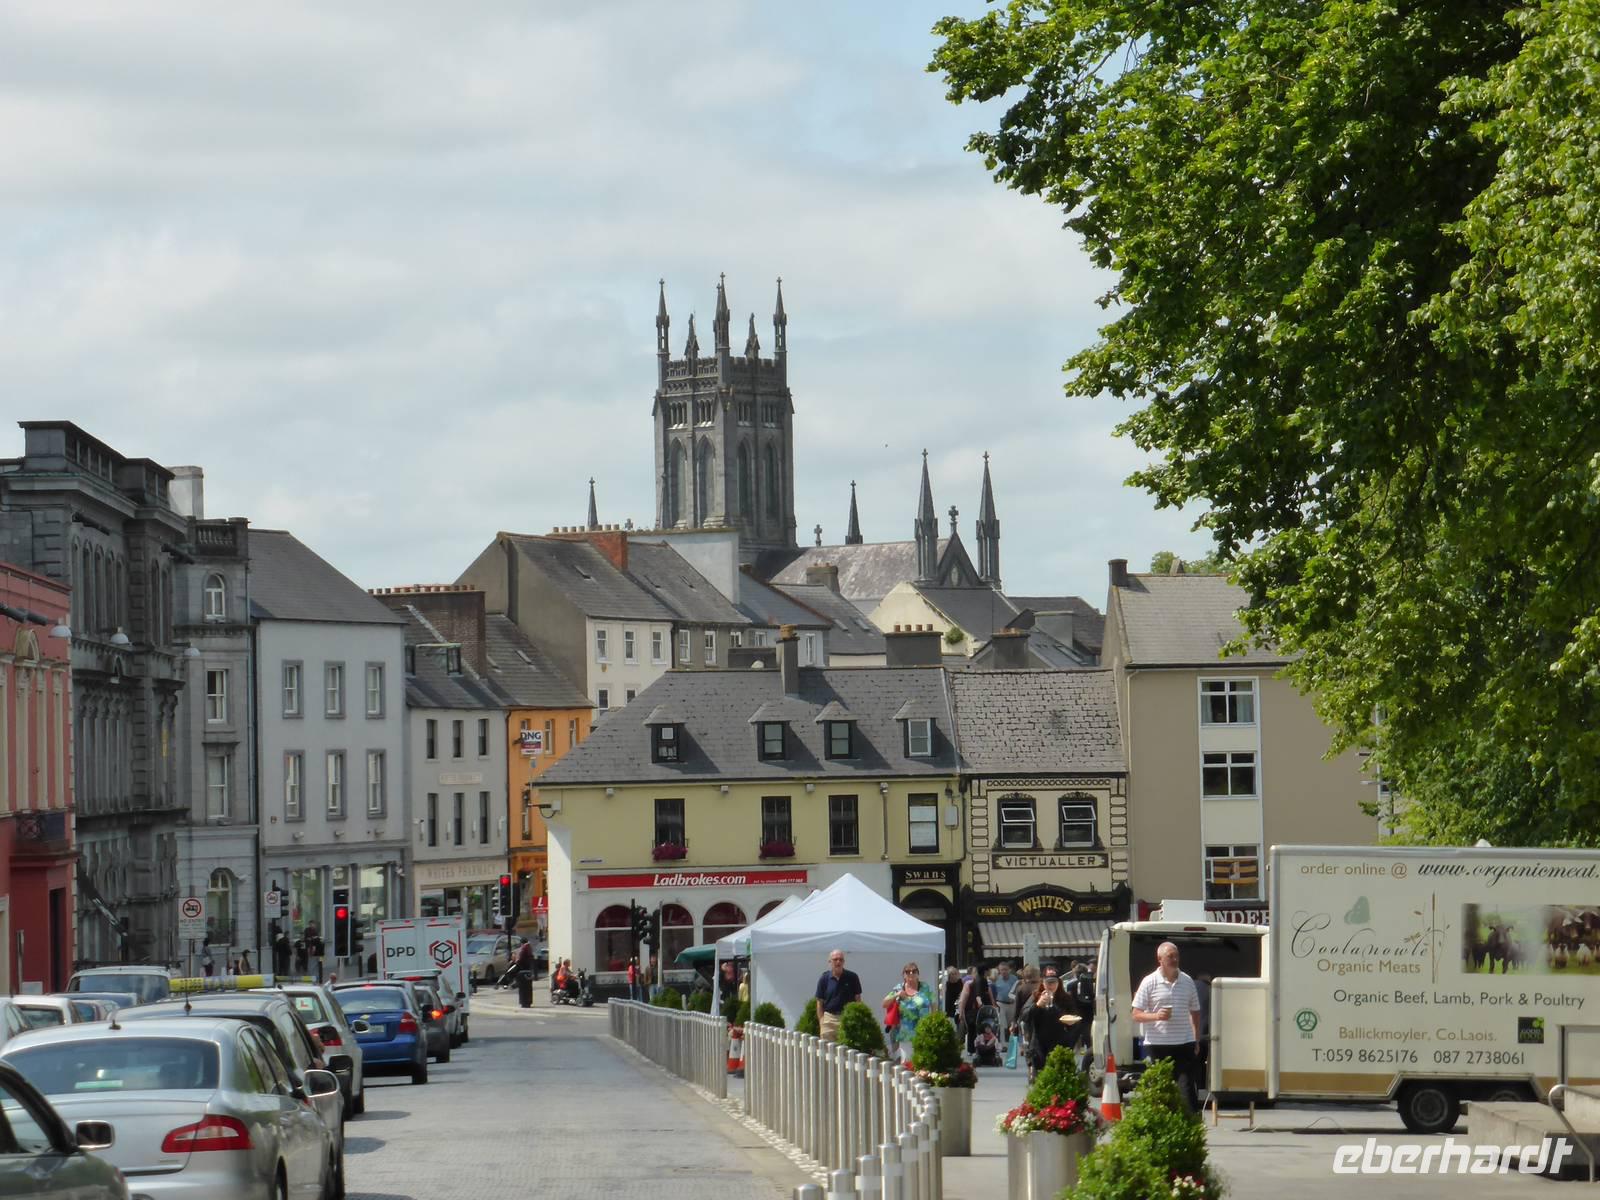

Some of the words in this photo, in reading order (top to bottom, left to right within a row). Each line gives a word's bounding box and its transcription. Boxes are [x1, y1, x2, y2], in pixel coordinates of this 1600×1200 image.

[1004, 856, 1096, 866] VICTUALLER
[1300, 863, 1339, 875] order
[1344, 862, 1386, 875] online
[1391, 862, 1408, 879] @
[653, 873, 746, 886] Ladbrokes.com
[1017, 895, 1074, 913] WHITES
[386, 946, 416, 957] DPD
[1317, 958, 1373, 976] Organic
[1379, 959, 1421, 973] Meats
[1333, 989, 1389, 1006] Organic
[1433, 991, 1475, 1006] Lamb,
[1480, 991, 1513, 1005] Pork
[1518, 993, 1528, 1006] &
[1534, 992, 1585, 1010] Poultry
[1312, 1048, 1353, 1062] T:059
[1358, 1049, 1419, 1063] 8625176
[1433, 1050, 1460, 1064] 087
[1466, 1050, 1525, 1065] 2738061
